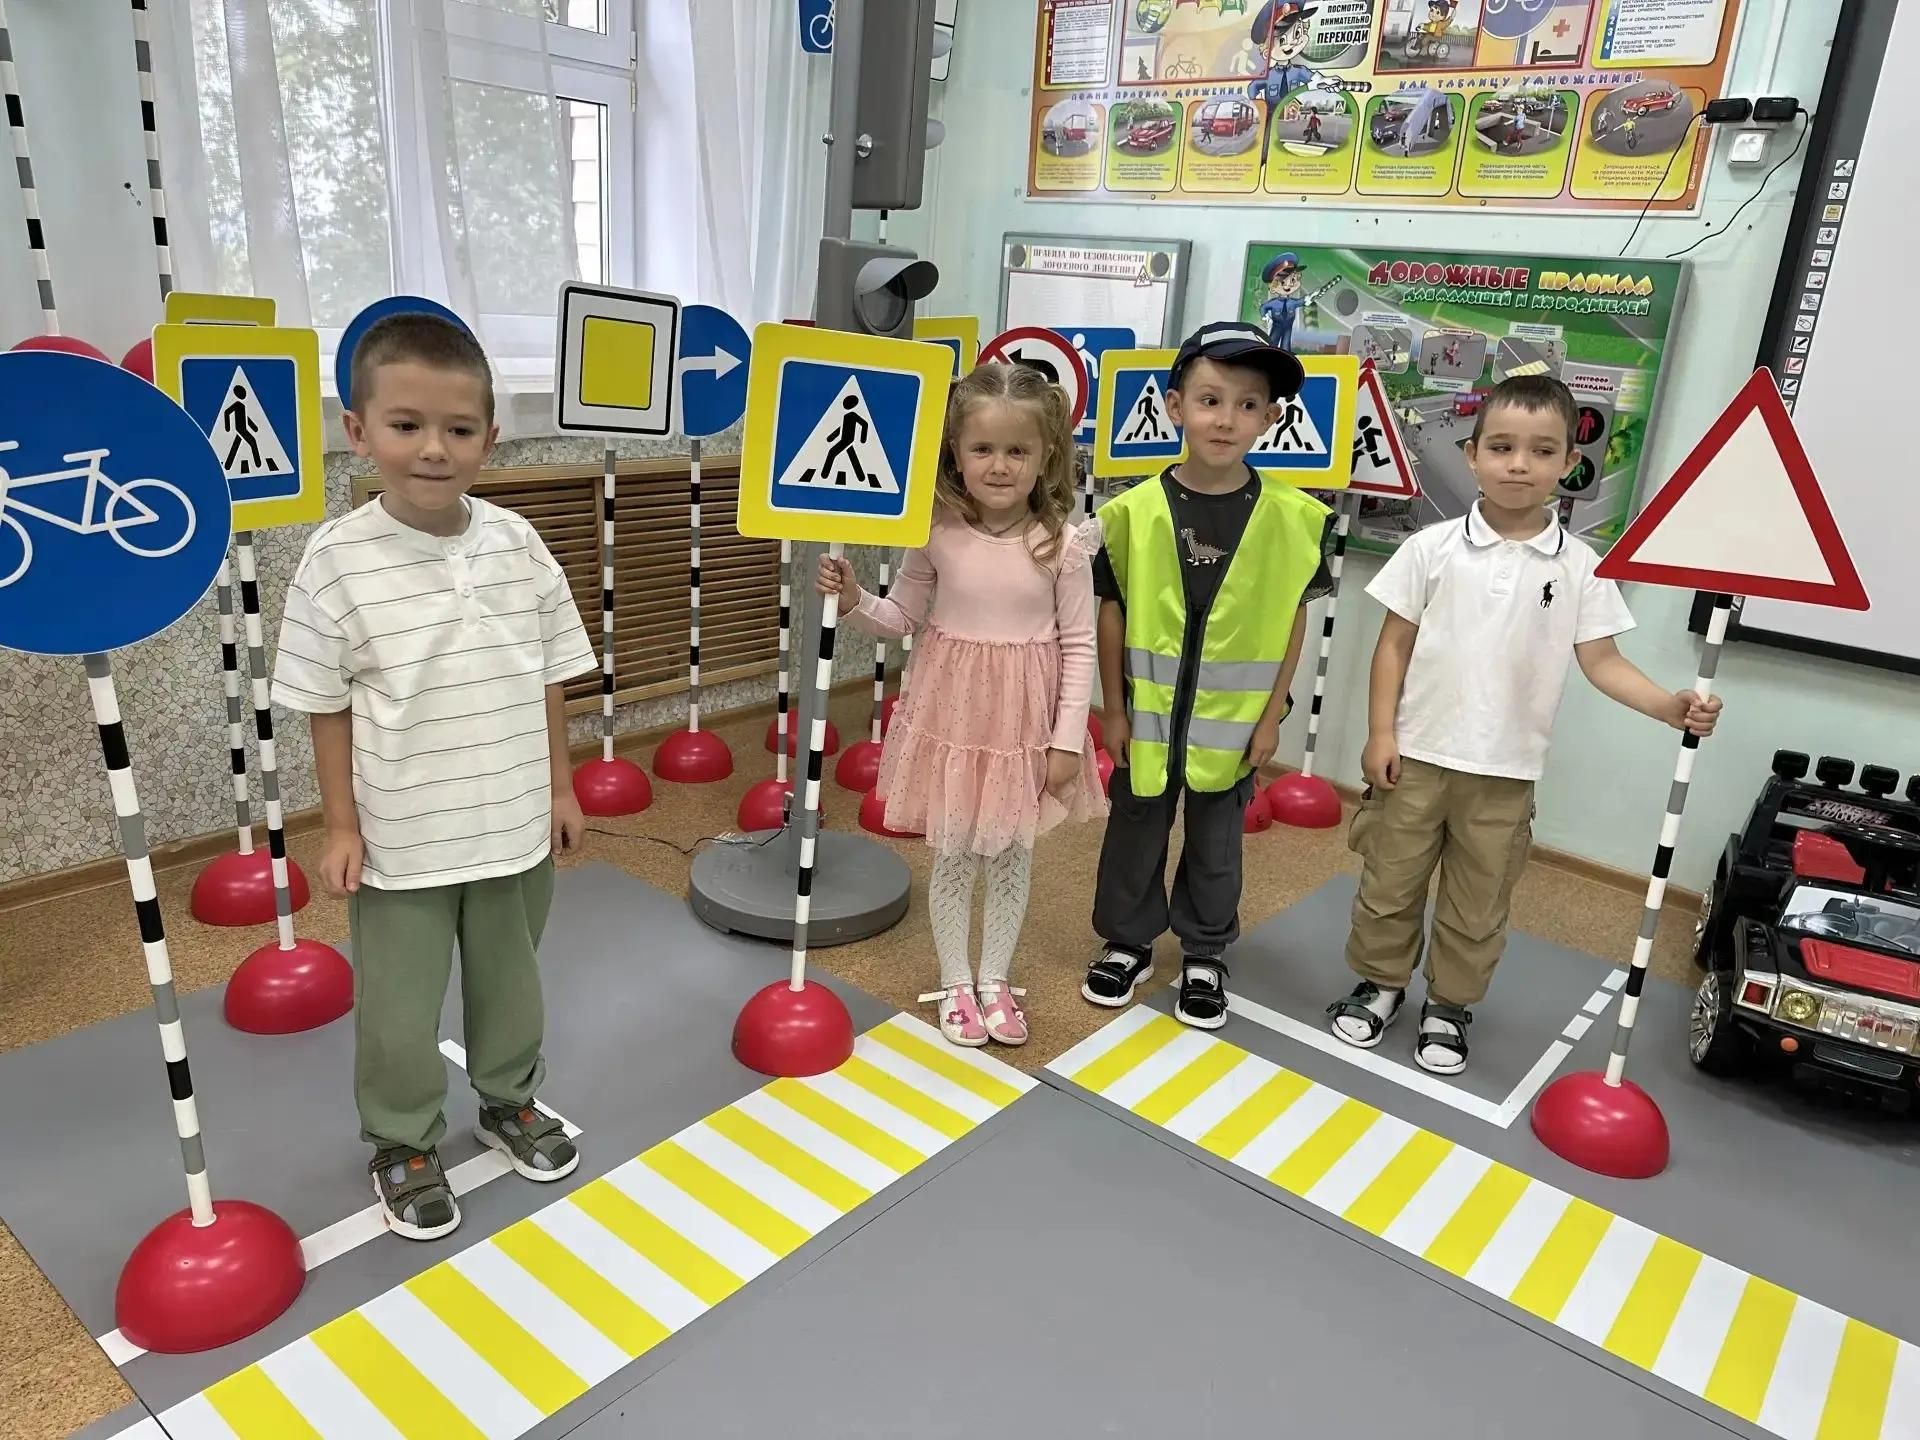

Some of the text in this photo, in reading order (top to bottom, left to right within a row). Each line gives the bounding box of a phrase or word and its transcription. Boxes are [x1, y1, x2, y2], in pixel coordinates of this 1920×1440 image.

[1320, 15, 1370, 26] ВНИМАТЕЛЬНО
[1317, 29, 1369, 44] ПЕРЕХОДИ
[1399, 72, 1643, 90] КАК ТАБЛИЦУ УМНОЖЕНИЯ!
[1071, 86, 1243, 101] ПОМНИ ПРАВИЛА ДВИЖЕНИЯ
[1367, 260, 1653, 297] ДОРОЖНЫЕ ПРАВИЛА
[1402, 287, 1650, 316] ДЛЯ МАЛЫШЕЙ И ИХ РОДИТЕЛЕЙ
